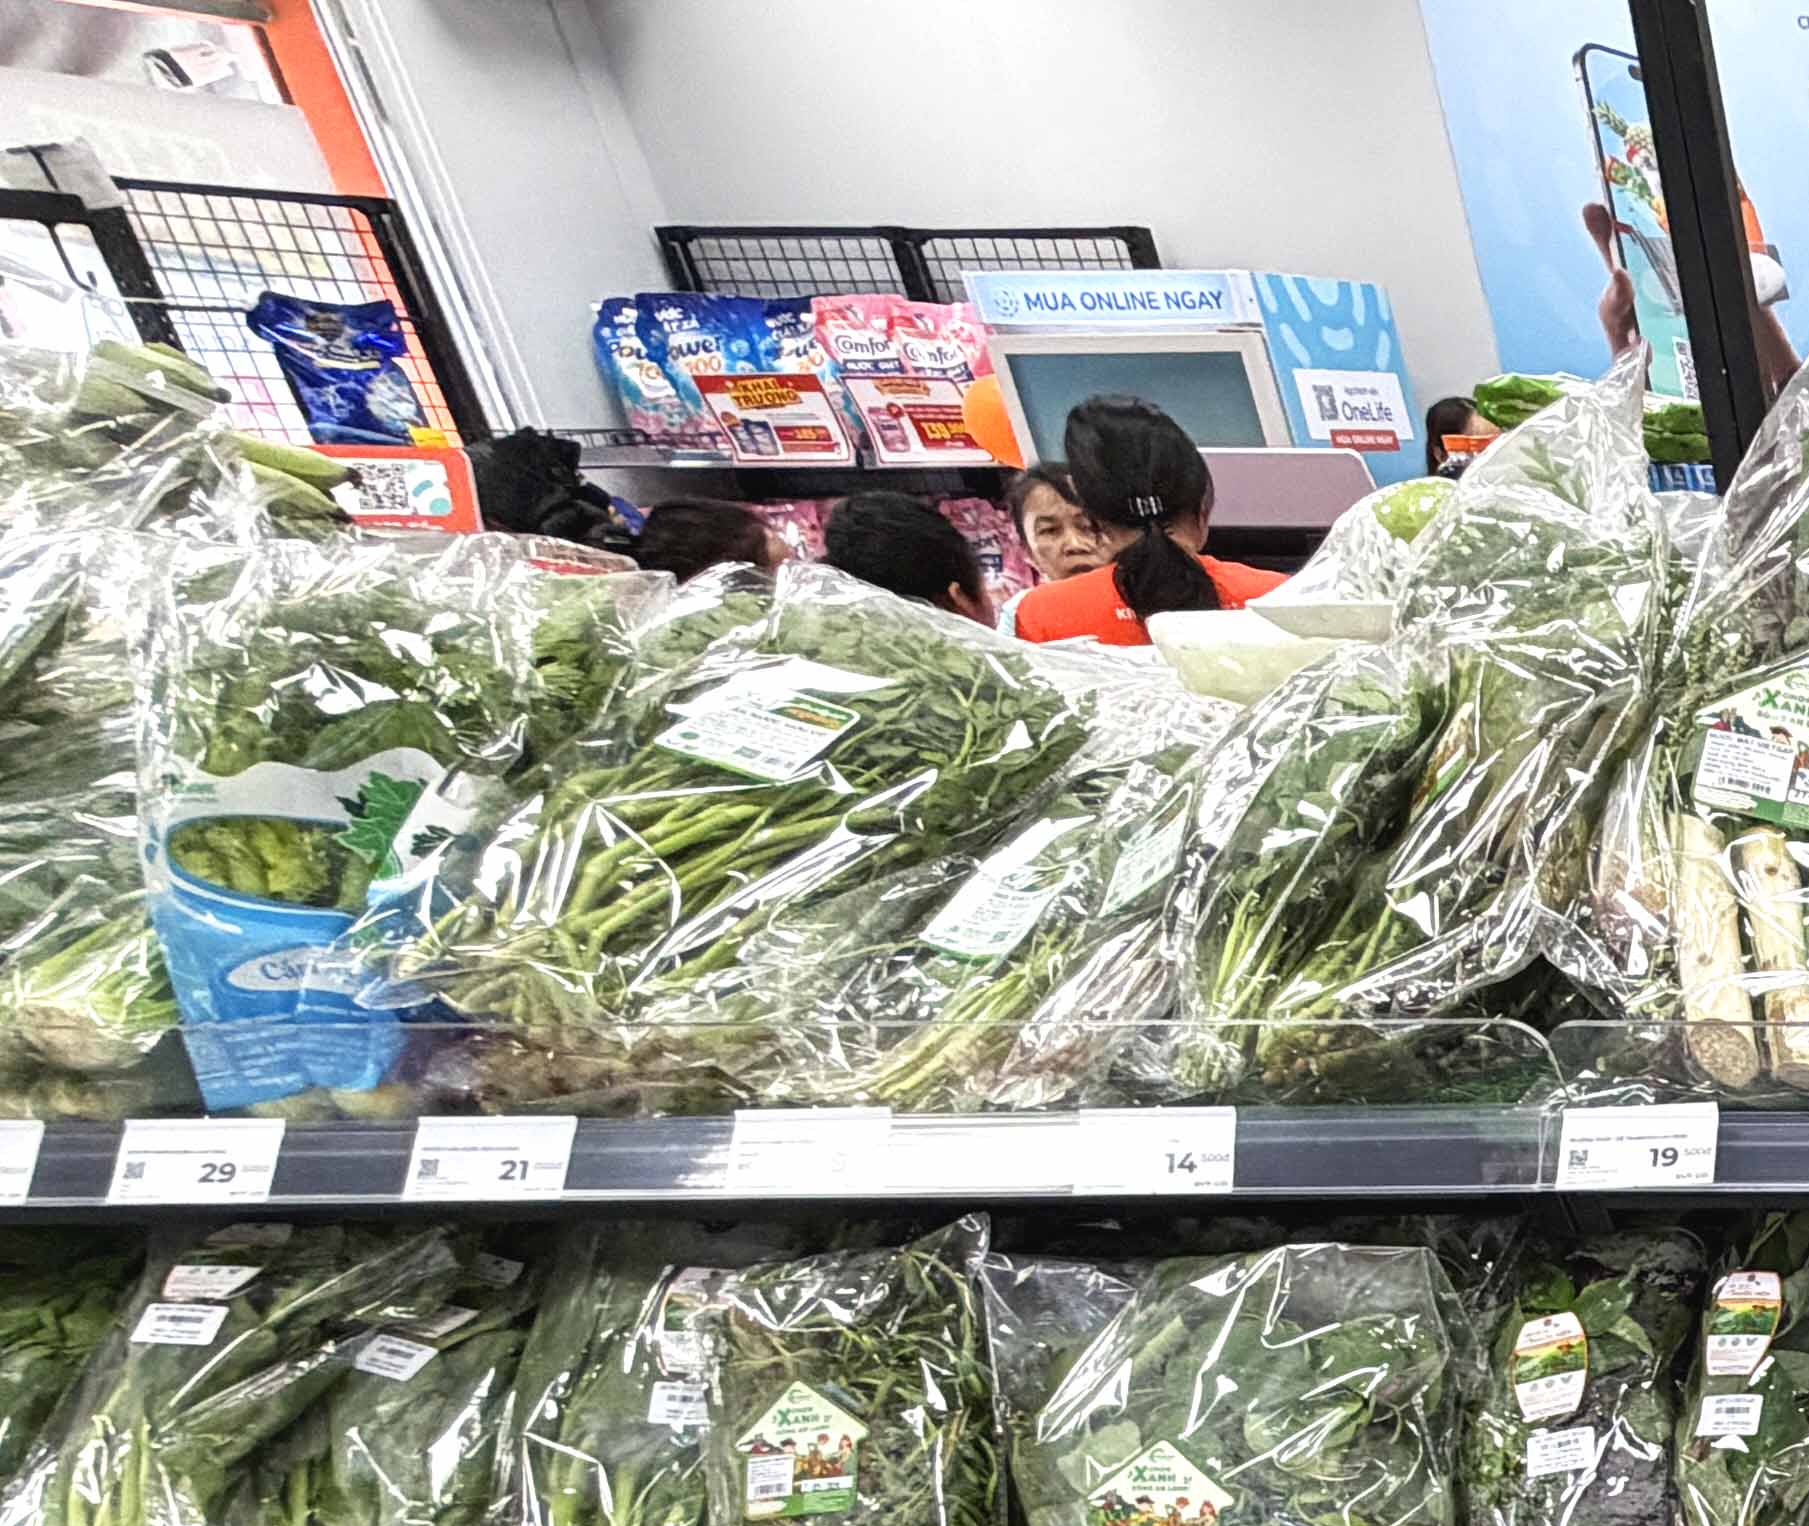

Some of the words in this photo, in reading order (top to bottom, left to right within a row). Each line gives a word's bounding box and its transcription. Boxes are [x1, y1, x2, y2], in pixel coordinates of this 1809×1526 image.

[1025, 290, 1076, 313] MUA
[1080, 289, 1160, 313] ONLINE
[1164, 289, 1224, 313] NGAY
[1341, 402, 1393, 423] OneLife
[1165, 1152, 1198, 1174] 14
[1649, 1146, 1679, 1168] 19
[197, 1162, 237, 1184] 29
[498, 1159, 529, 1181] 21
